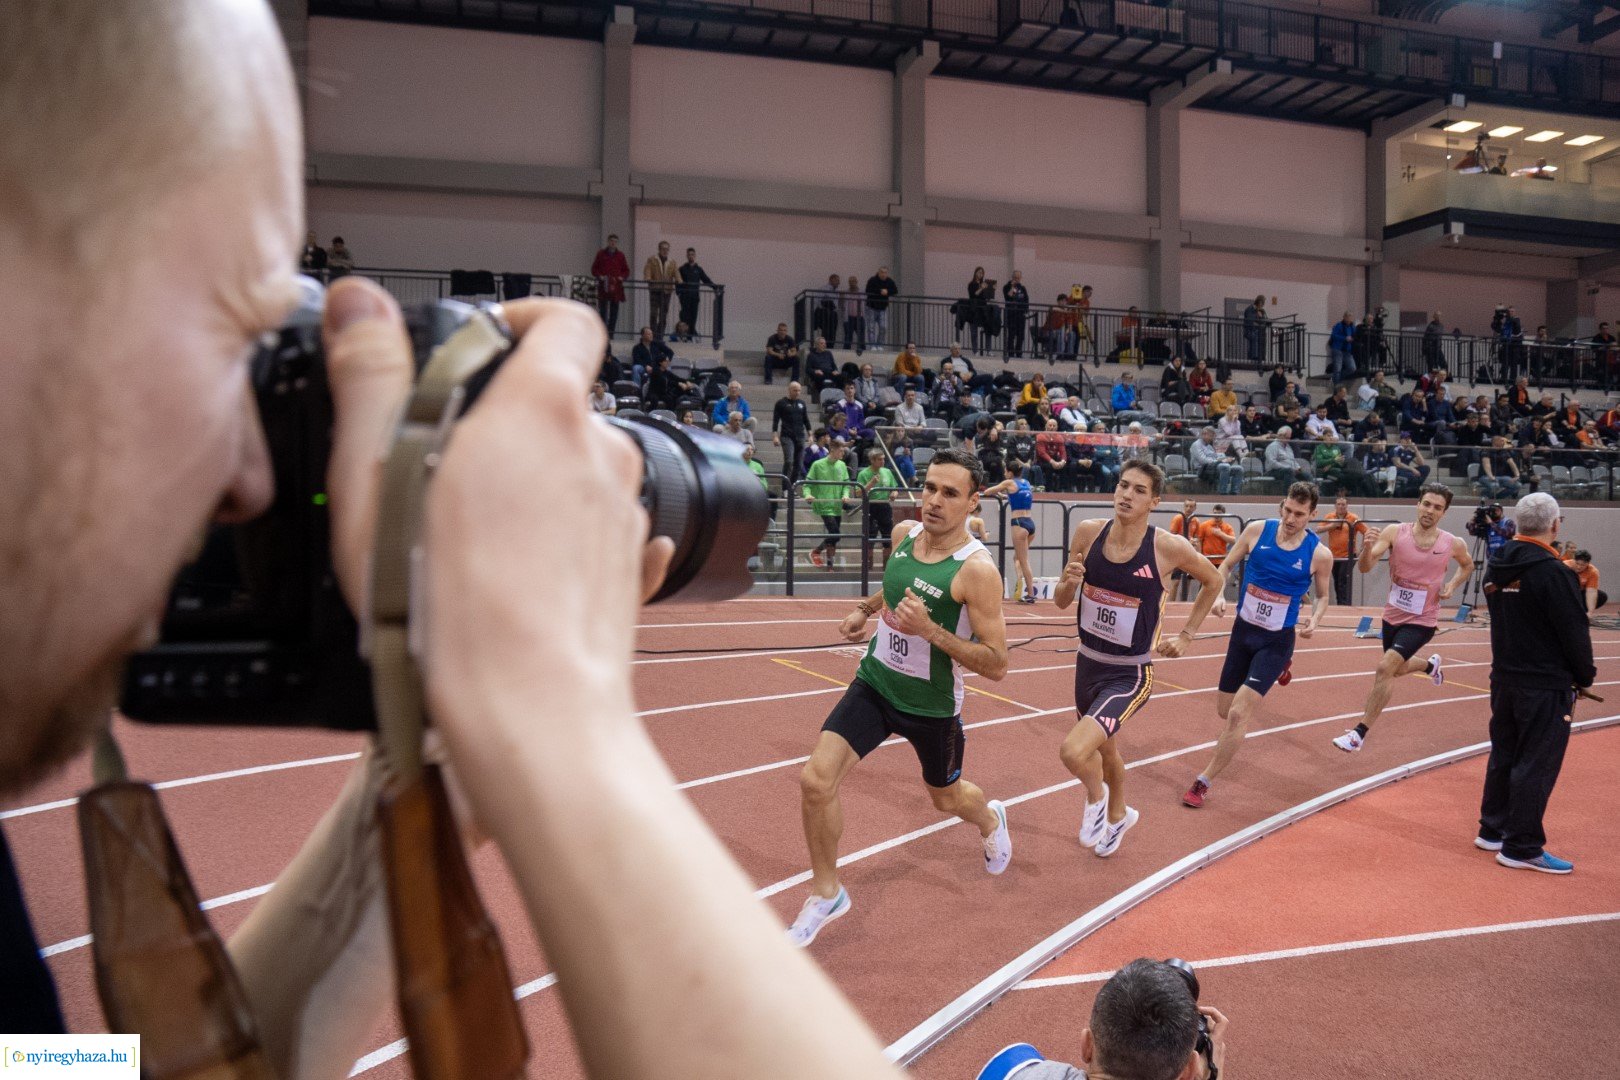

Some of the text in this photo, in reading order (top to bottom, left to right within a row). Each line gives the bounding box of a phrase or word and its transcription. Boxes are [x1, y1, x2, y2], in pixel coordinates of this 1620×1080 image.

[1399, 589, 1414, 603] 152
[1096, 606, 1117, 626] 166
[1256, 602, 1273, 617] 193
[889, 632, 908, 656] 180
